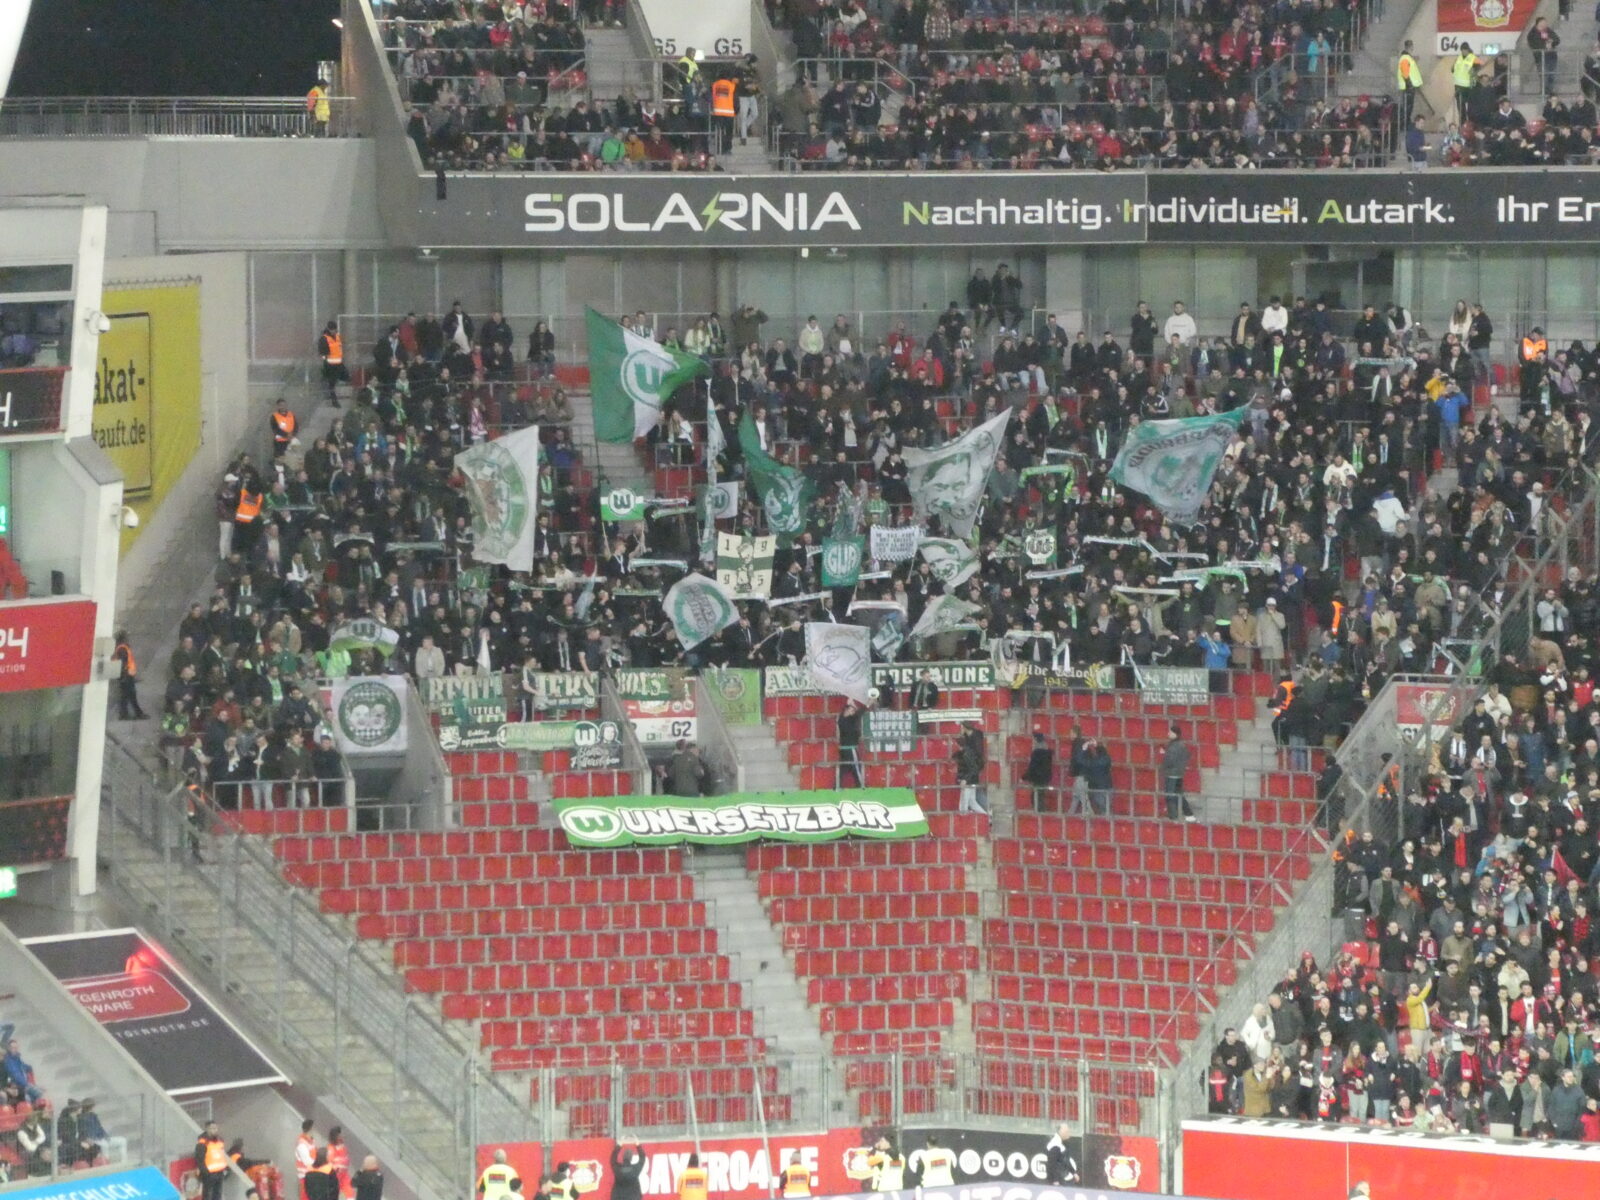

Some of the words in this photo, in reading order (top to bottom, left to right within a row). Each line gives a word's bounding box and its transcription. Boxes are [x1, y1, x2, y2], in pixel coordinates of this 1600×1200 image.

[714, 38, 743, 55] G5
[1441, 36, 1459, 52] G4
[525, 192, 862, 232] SOLARNIA
[903, 198, 1112, 230] Nachhaltig.
[1123, 197, 1308, 224] Individuell.
[1318, 197, 1455, 224] Autark.
[1498, 197, 1549, 223] Ihr
[671, 721, 693, 738] G2
[618, 802, 893, 834] UNERSETZBAR
